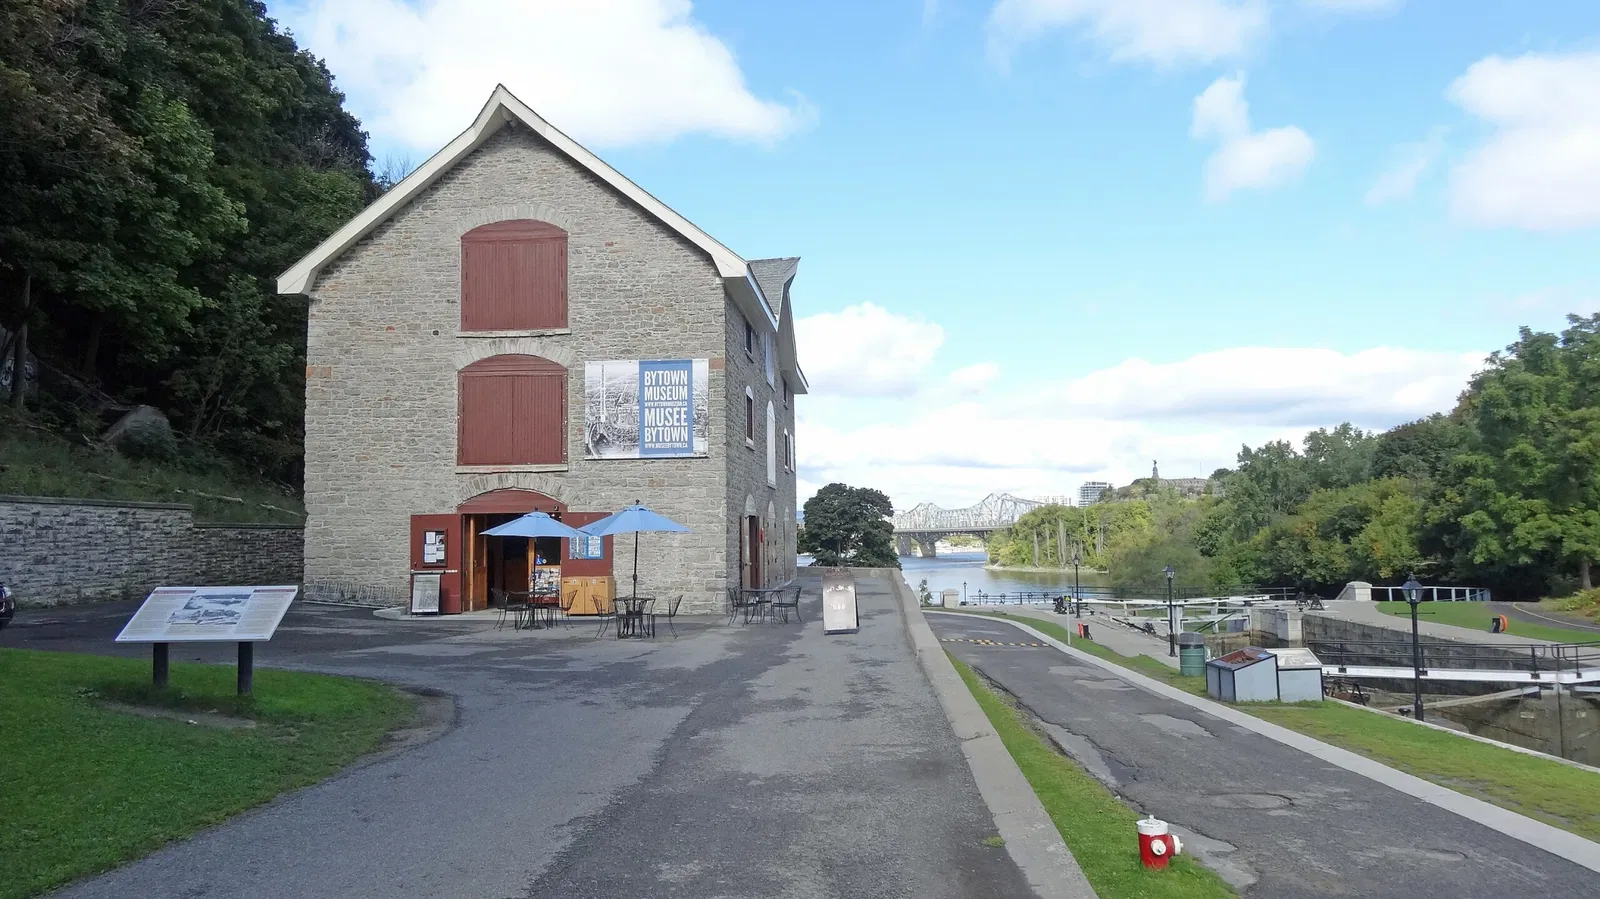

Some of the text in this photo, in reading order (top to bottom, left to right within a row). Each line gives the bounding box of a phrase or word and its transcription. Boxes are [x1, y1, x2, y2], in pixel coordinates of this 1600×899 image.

[644, 370, 688, 386] BYTOWN
[644, 385, 688, 401] MUSEUM
[644, 427, 688, 442] BYTOWN
